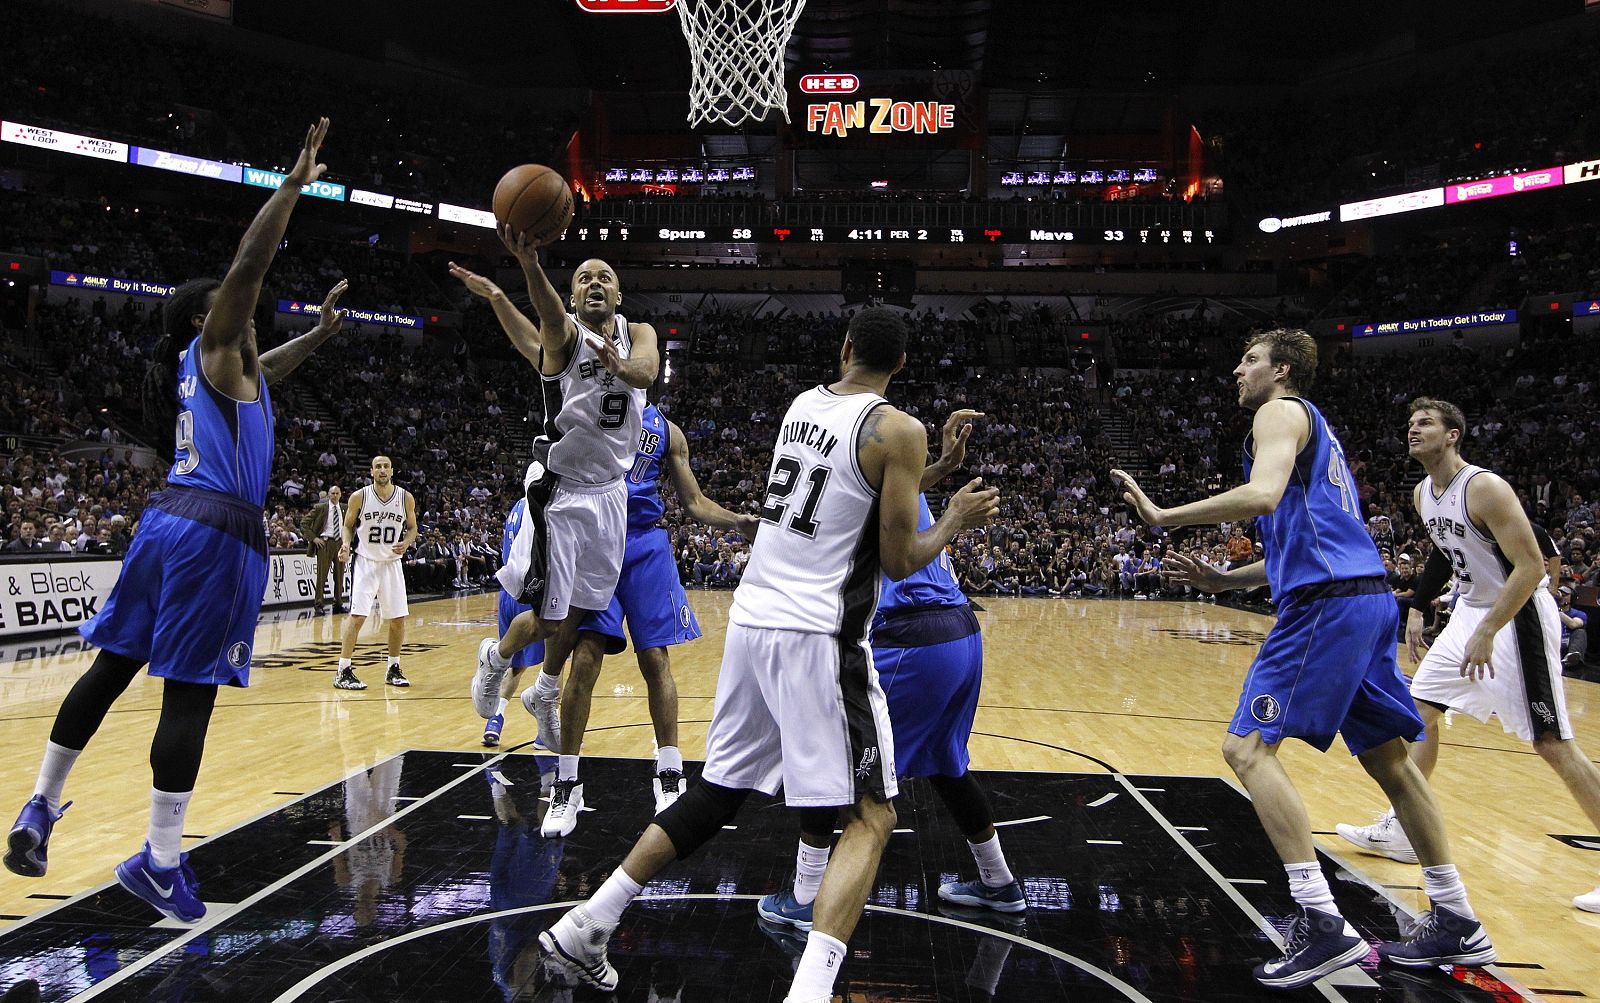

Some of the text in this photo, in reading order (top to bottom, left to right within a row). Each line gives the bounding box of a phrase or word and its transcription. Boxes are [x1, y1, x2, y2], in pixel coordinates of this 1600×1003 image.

[807, 98, 956, 138] FAN ZONE
[27, 127, 53, 137] WEST
[32, 135, 58, 144] LOOP
[88, 139, 113, 148] WEST
[93, 146, 118, 155] LOOP
[247, 170, 342, 197] WINSTOP
[658, 228, 752, 241] Spurs 58
[810, 228, 824, 236] TOL
[847, 229, 928, 240] 4:11 PER 2
[1030, 229, 1125, 241] Mavs 33
[82, 276, 109, 286] ASHLEY
[113, 279, 131, 291] Buy
[133, 282, 139, 291] It
[141, 283, 168, 296] Today
[303, 304, 323, 312] ASHLE
[351, 309, 373, 321] Today
[373, 313, 387, 322] Get
[388, 314, 393, 323] It
[394, 315, 416, 327] Today
[1403, 321, 1419, 331] Buy
[1420, 320, 1426, 328] It
[1428, 318, 1453, 328] Today
[1454, 316, 1470, 325] Get
[1471, 315, 1478, 323] It
[1479, 313, 1506, 323] Today
[598, 390, 631, 431] 9
[175, 410, 200, 475] 9
[782, 421, 838, 458] DUNCAN
[1327, 445, 1361, 521] 41
[760, 454, 833, 541] 21
[364, 511, 403, 523] SPURS
[368, 526, 396, 544] 20
[293, 559, 318, 576] Silv
[8, 570, 94, 596] & Black
[15, 595, 98, 627] BACK
